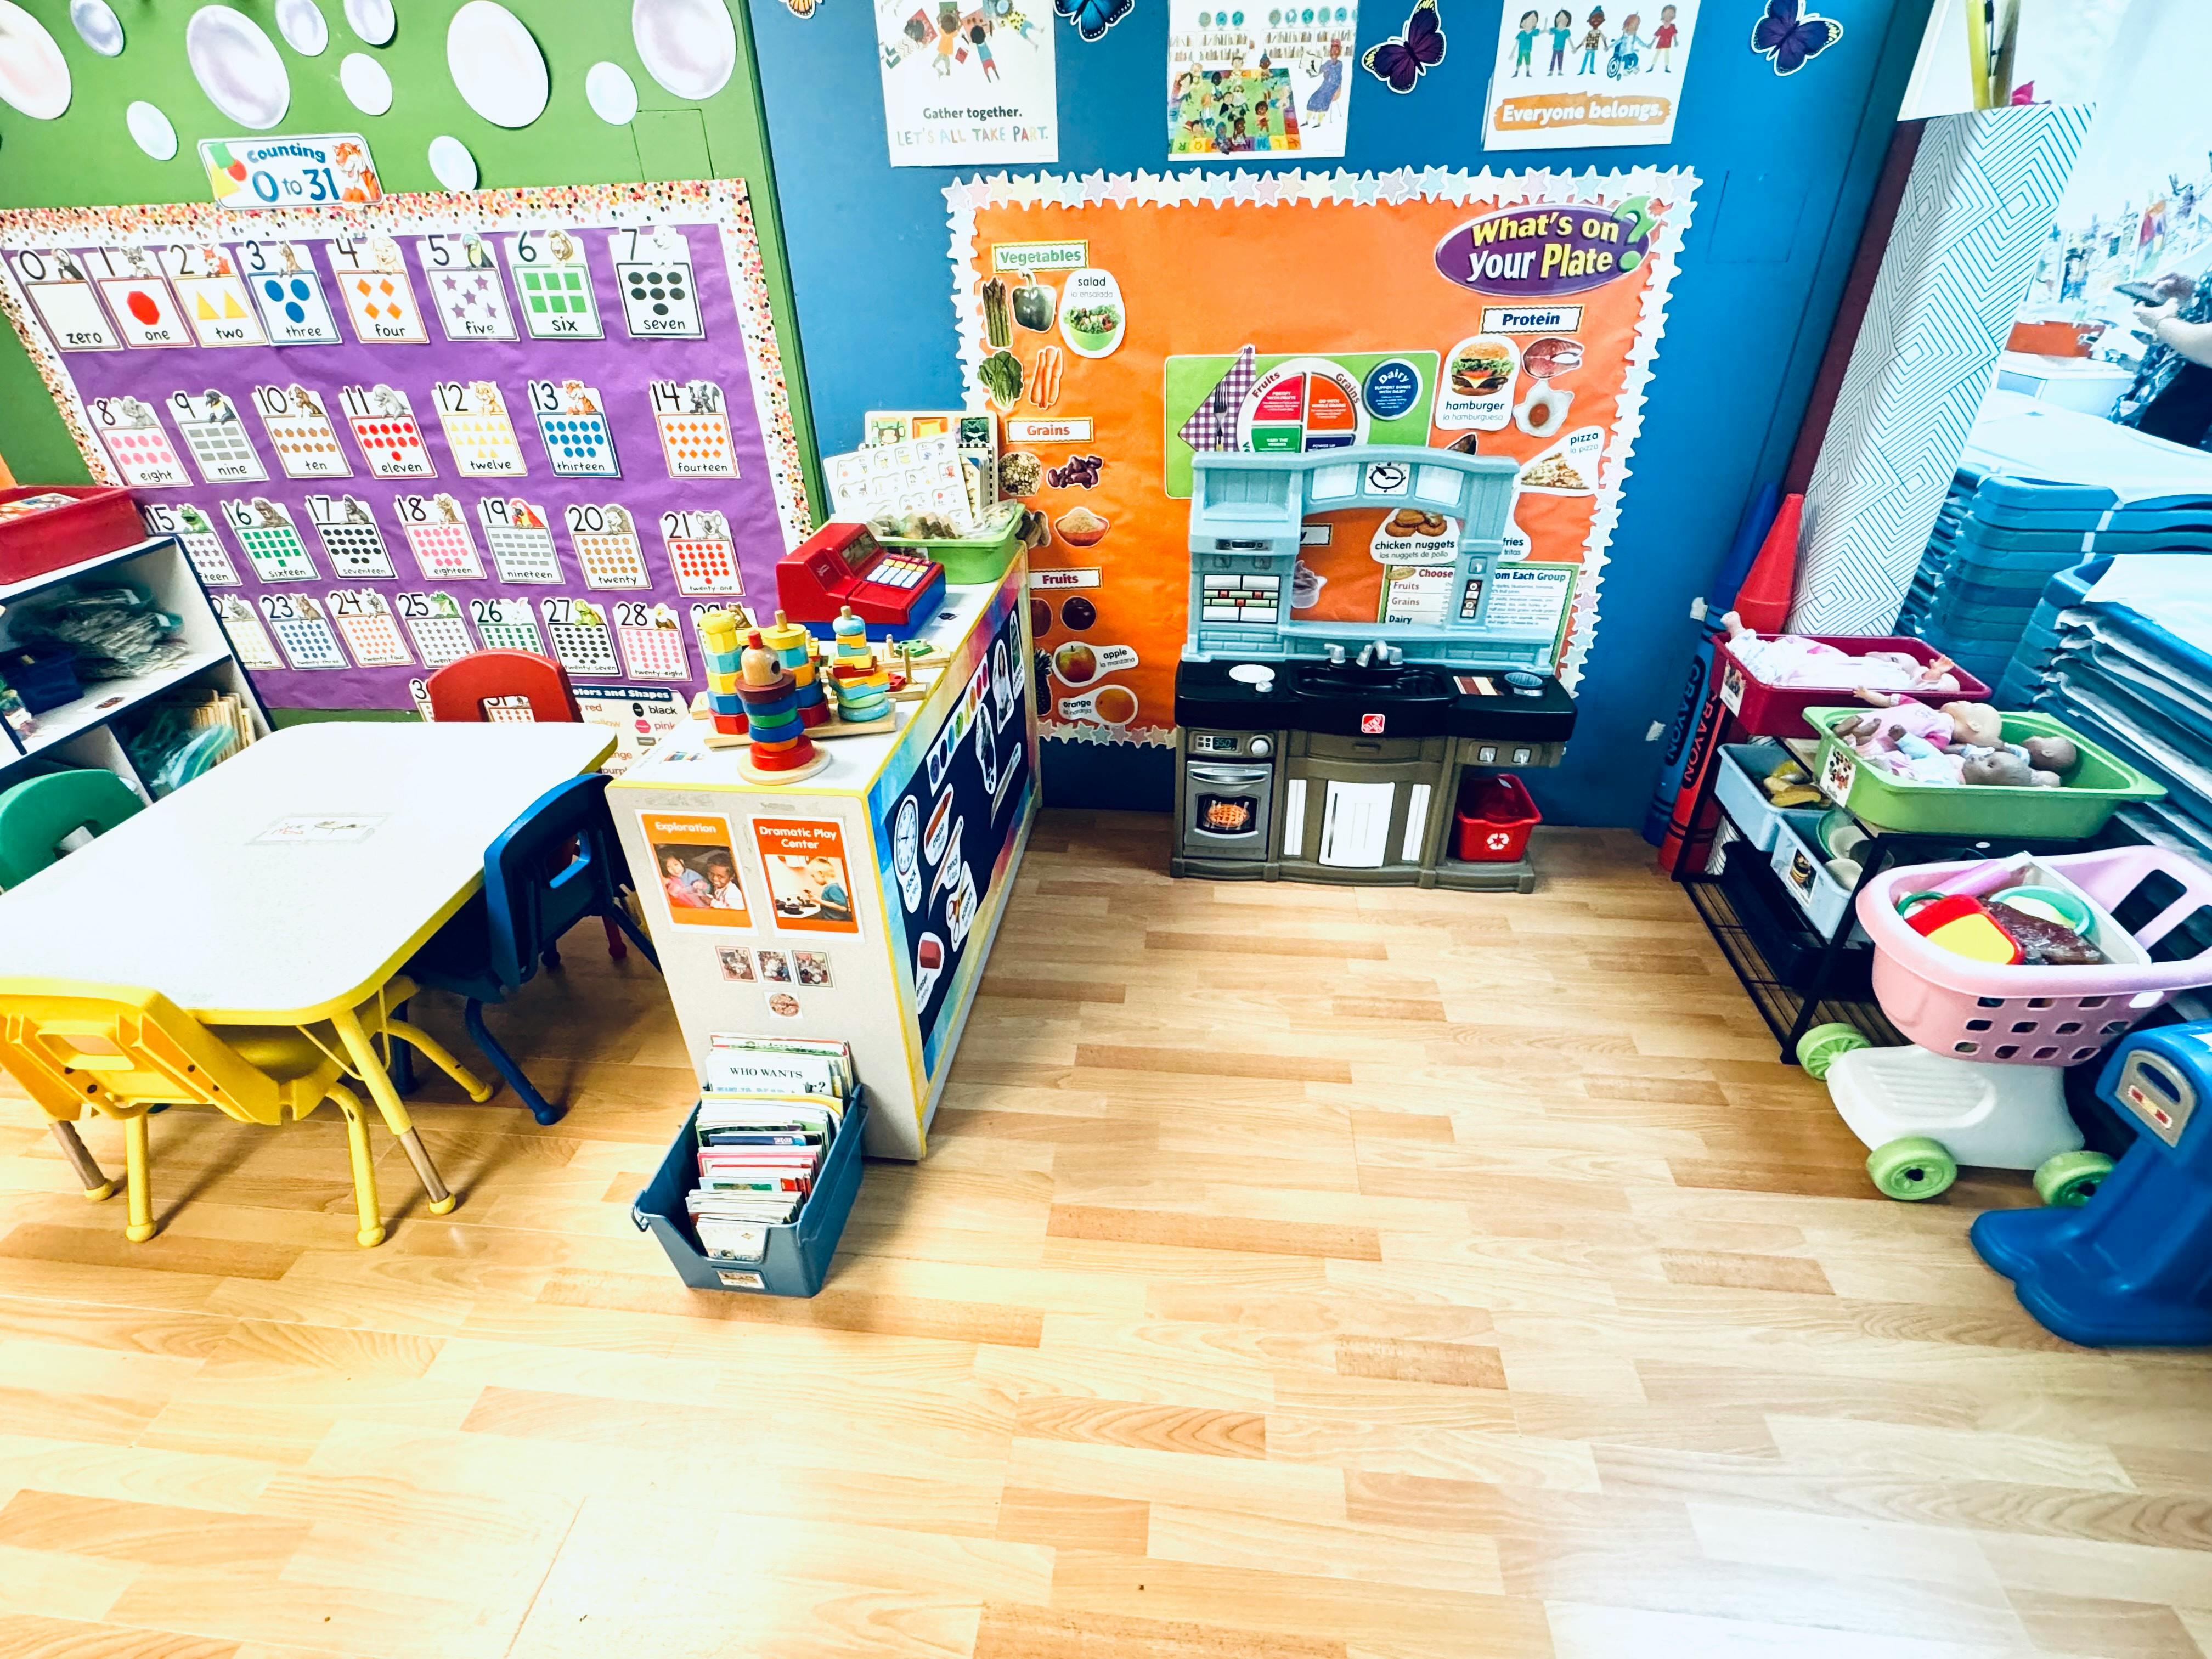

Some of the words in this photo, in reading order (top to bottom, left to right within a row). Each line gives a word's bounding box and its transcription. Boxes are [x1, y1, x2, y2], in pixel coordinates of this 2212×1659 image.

[923, 108, 963, 120] Gather
[967, 107, 1022, 121] together.
[1503, 105, 1584, 125] Everyone
[1589, 101, 1663, 121] belongs.
[897, 128, 934, 146] LET'S
[940, 128, 962, 144] ALL
[972, 128, 1005, 142] TAKE
[1013, 126, 1048, 142] PART.
[252, 171, 279, 202] 0
[281, 178, 302, 195] to
[302, 168, 340, 201] 31
[1472, 212, 1572, 246] What's
[1582, 219, 1619, 243] on
[428, 235, 450, 266] 5
[518, 231, 537, 262] 6
[621, 229, 637, 260] 7
[170, 245, 195, 275] 2
[246, 240, 265, 270] 3
[336, 238, 359, 268] 4
[1000, 249, 1081, 266] Vegetables
[19, 250, 46, 280] 0
[98, 246, 115, 277] 1
[1468, 251, 1536, 281] your
[1078, 277, 1106, 286] salad
[552, 315, 578, 332] six
[644, 319, 685, 331] seven
[1502, 312, 1560, 326] Protein
[216, 328, 244, 339] two
[286, 326, 321, 338] three
[376, 325, 405, 337] four
[466, 321, 494, 335] five
[66, 331, 102, 346] zero
[145, 330, 170, 341] one
[1379, 369, 1409, 384] Dairy
[1252, 372, 1280, 398] Fruits
[1336, 373, 1360, 404] Grains
[256, 387, 287, 414] 10
[343, 386, 369, 415] 11
[438, 384, 468, 412] 12
[532, 383, 558, 410] 13
[654, 383, 680, 411] 14
[97, 400, 114, 425] 8
[175, 393, 196, 418] 9
[1446, 401, 1505, 411] hamburger
[1027, 425, 1070, 436] Grains
[1570, 432, 1598, 445] pizza
[1579, 444, 1598, 453] pizza
[218, 463, 247, 476] nine
[306, 460, 328, 471] ten
[382, 461, 422, 473] eleven
[470, 460, 512, 470] twelve
[557, 460, 605, 472] thirteen
[678, 462, 728, 472] fourteen
[140, 470, 173, 484] eight
[223, 500, 252, 528] 16
[306, 498, 331, 522] 17
[397, 498, 426, 522] 18
[483, 500, 509, 524] 19
[145, 507, 174, 531] 15
[573, 506, 603, 532] 20
[665, 514, 692, 539] 21
[1375, 541, 1411, 550] chicken
[1415, 540, 1455, 550] nuggets
[1503, 538, 1523, 546] fries
[199, 573, 229, 581] teen
[269, 567, 306, 578] sixteen
[342, 568, 387, 576] seventeen
[434, 566, 472, 576] eighteen
[507, 568, 553, 579] nineteen
[1419, 569, 1453, 578] Choose
[1513, 572, 1534, 580] Each
[1537, 572, 1566, 582] Group
[598, 574, 637, 587] twenty
[1042, 574, 1079, 584] Fruits
[1393, 582, 1419, 590] Fruits
[212, 597, 229, 619] 2
[262, 596, 294, 619] 23
[330, 590, 363, 615] 24
[398, 595, 430, 617] 25
[1392, 597, 1419, 606] Grains
[472, 601, 503, 623] 26
[544, 599, 571, 622] 27
[617, 603, 647, 626] 28
[1389, 615, 1412, 624] Dairy
[1103, 648, 1127, 659] apple
[1108, 657, 1135, 666] manzana
[412, 680, 429, 699] 3
[628, 690, 669, 699] Shapes
[648, 706, 677, 714] black
[1063, 699, 1091, 708] orange
[1667, 664, 1700, 759] CRAYON
[602, 767, 627, 775] purp
[654, 822, 716, 834] Exploration
[759, 826, 811, 838] Dramatic
[814, 828, 837, 841] Play
[781, 838, 819, 849] Center
[730, 1068, 757, 1076] WHO
[760, 1069, 803, 1078] WANTS
